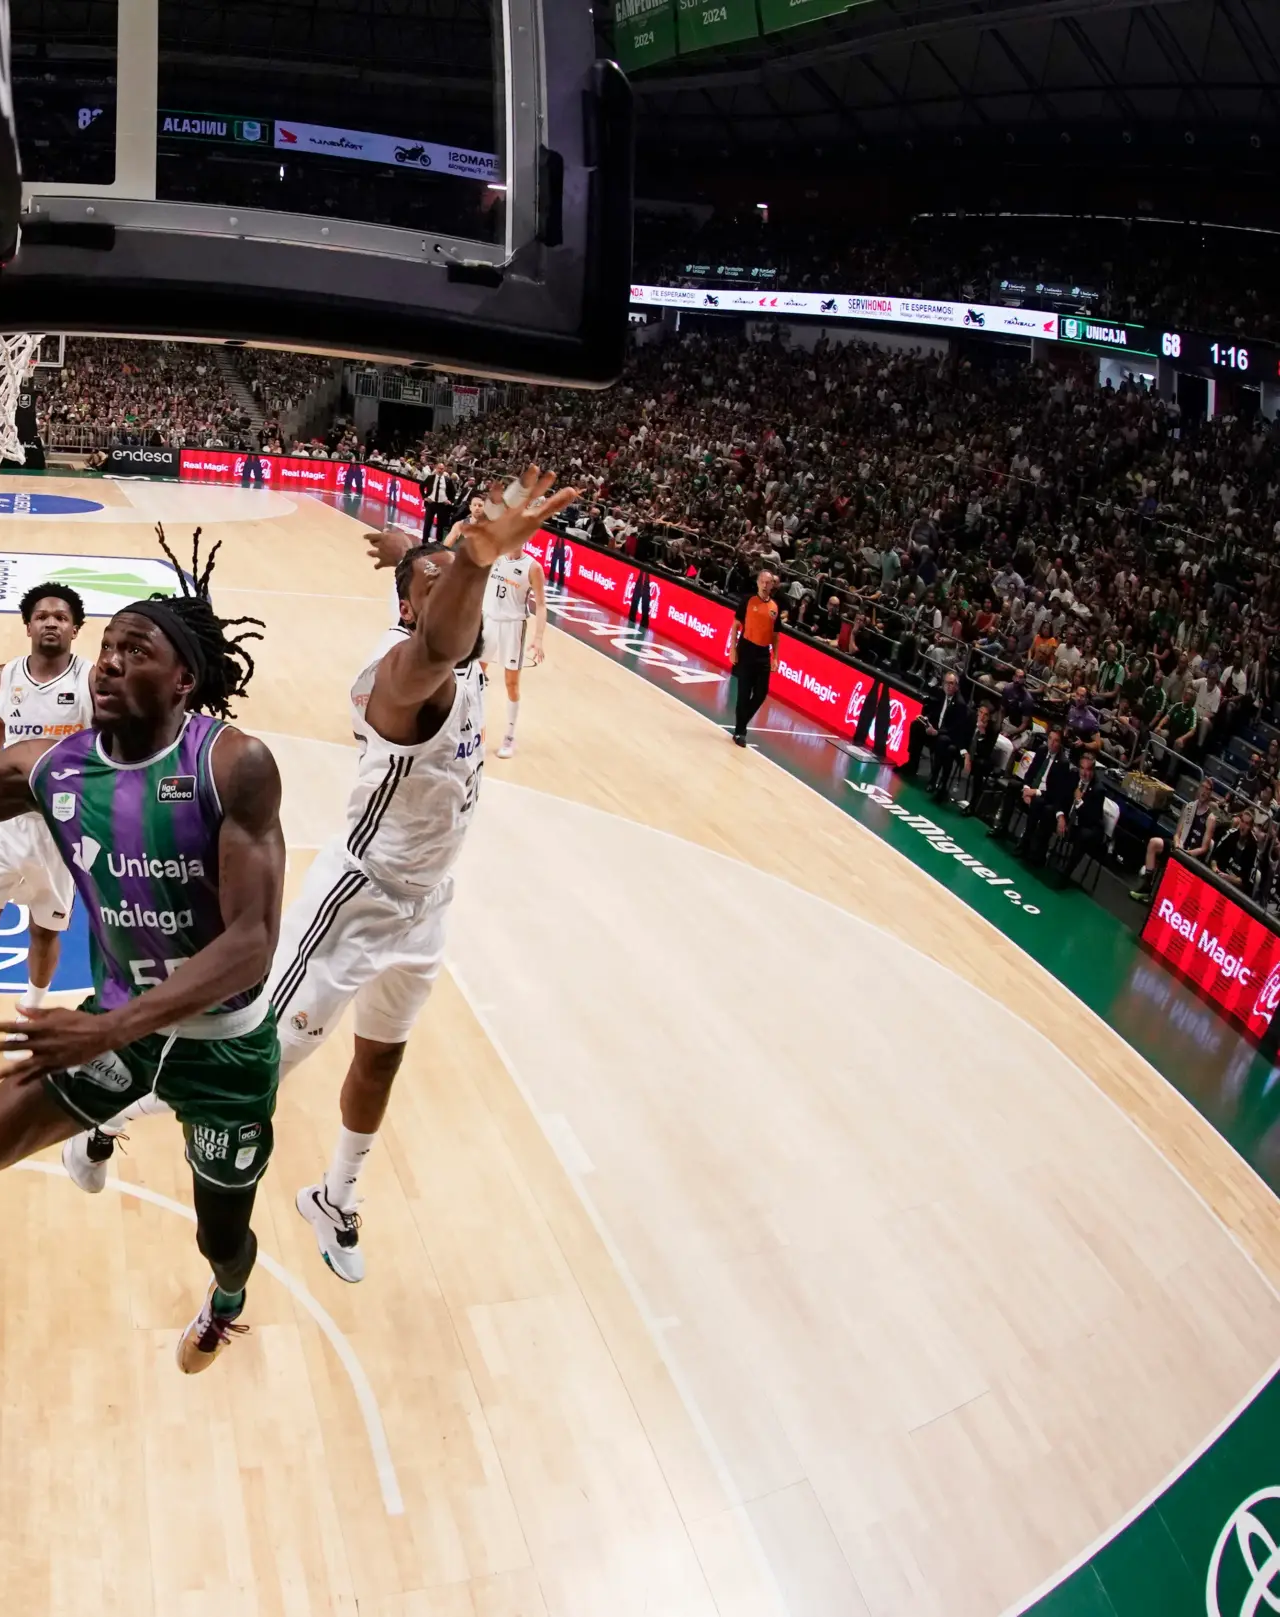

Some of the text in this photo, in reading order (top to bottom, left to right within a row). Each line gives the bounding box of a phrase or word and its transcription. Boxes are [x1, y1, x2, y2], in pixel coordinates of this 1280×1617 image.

[703, 7, 728, 25] 2024
[634, 31, 655, 48] 2024
[848, 298, 892, 312] SERVIHONDA
[911, 303, 954, 315] ESPERAMOS!
[1086, 325, 1127, 345] UNICAJA
[1162, 332, 1181, 358] 68
[1210, 343, 1249, 370] 1:16
[112, 448, 172, 463] endesa
[183, 461, 202, 470] Real
[203, 463, 229, 472] Magic
[281, 469, 299, 478] Real
[300, 471, 326, 481] Magic
[579, 564, 617, 591] Real Magic
[495, 584, 507, 599] 13
[668, 605, 715, 638] Real Magic
[778, 660, 838, 704] Real Magic
[161, 783, 177, 792] liga
[161, 789, 193, 799] endesa
[844, 778, 910, 822] San
[907, 814, 1015, 885] Miguel
[107, 853, 205, 884] Unicaja
[100, 899, 194, 935] málaga
[1158, 898, 1251, 985] Real Magic
[241, 1130, 257, 1140] acb
